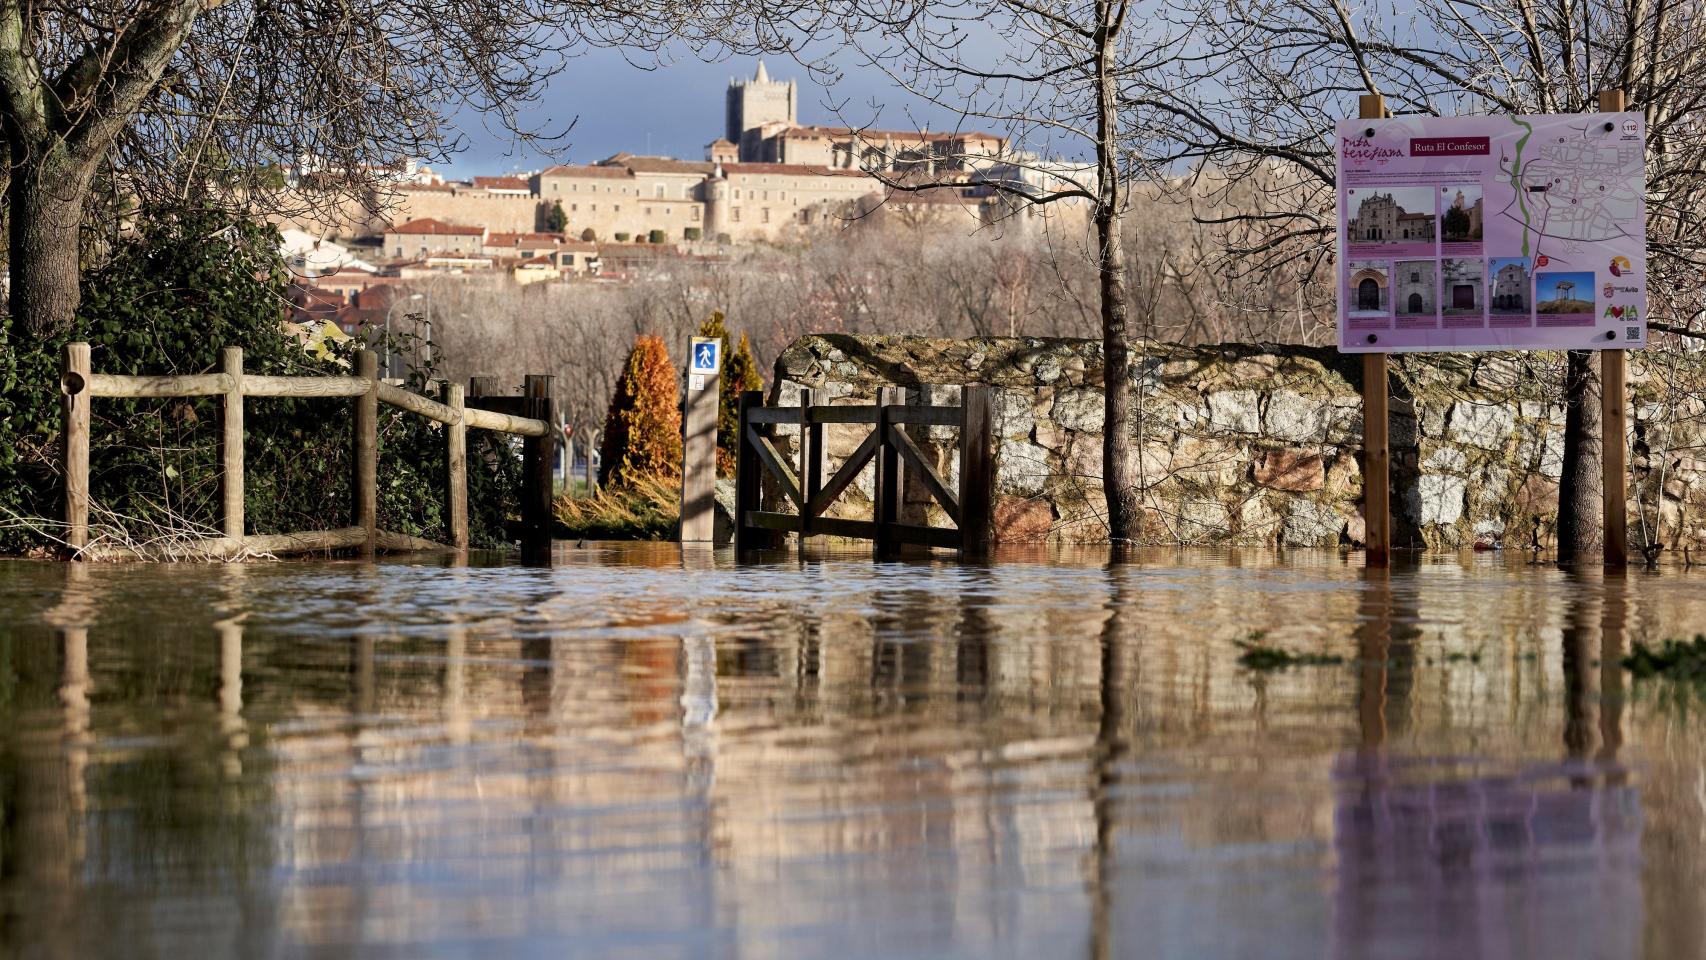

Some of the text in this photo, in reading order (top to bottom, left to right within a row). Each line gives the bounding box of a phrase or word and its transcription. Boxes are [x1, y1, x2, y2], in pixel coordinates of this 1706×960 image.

[1415, 141, 1485, 152] Ruta El Confesor
